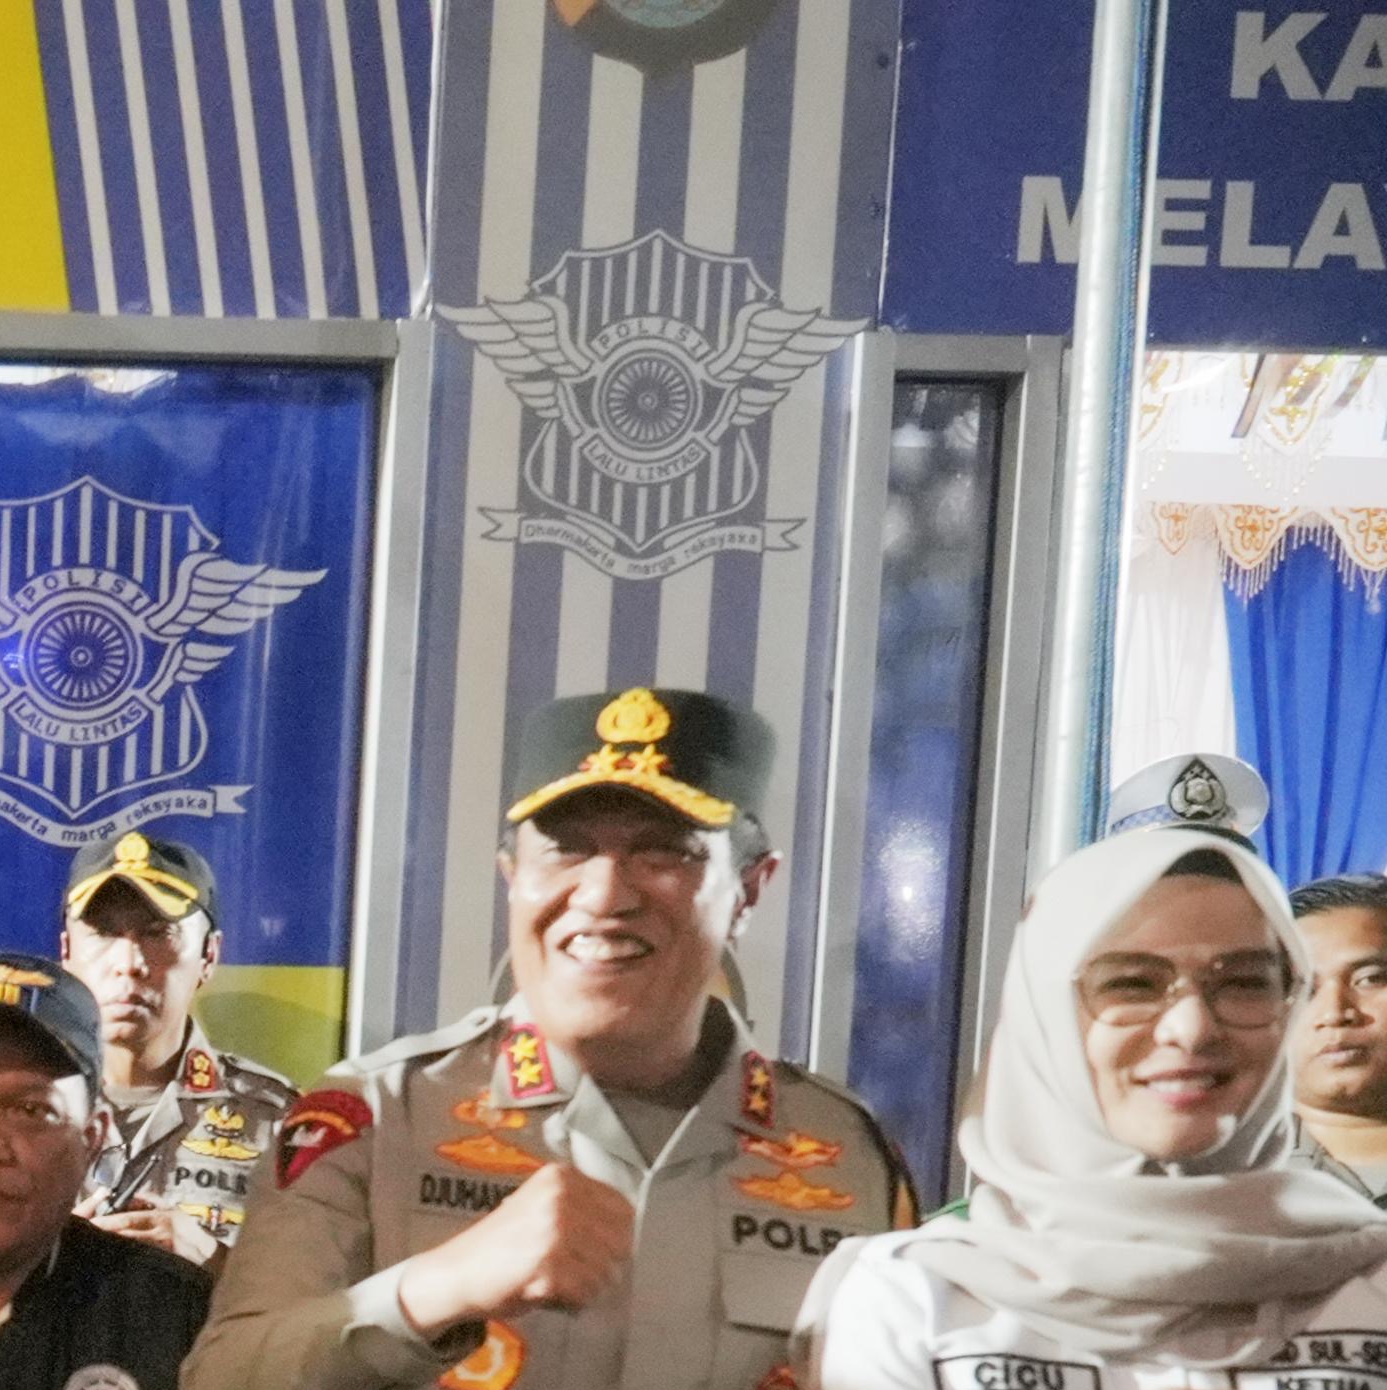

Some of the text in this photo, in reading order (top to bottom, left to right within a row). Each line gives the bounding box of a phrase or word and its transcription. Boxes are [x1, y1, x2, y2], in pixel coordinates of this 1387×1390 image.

[1230, 11, 1387, 101] KA
[1017, 176, 1387, 270] MELA
[599, 319, 704, 351] POLISI
[25, 567, 143, 609] POLISI
[15, 702, 145, 742] LALU LINTAS
[61, 821, 116, 843] marga
[732, 1213, 856, 1256] POLR
